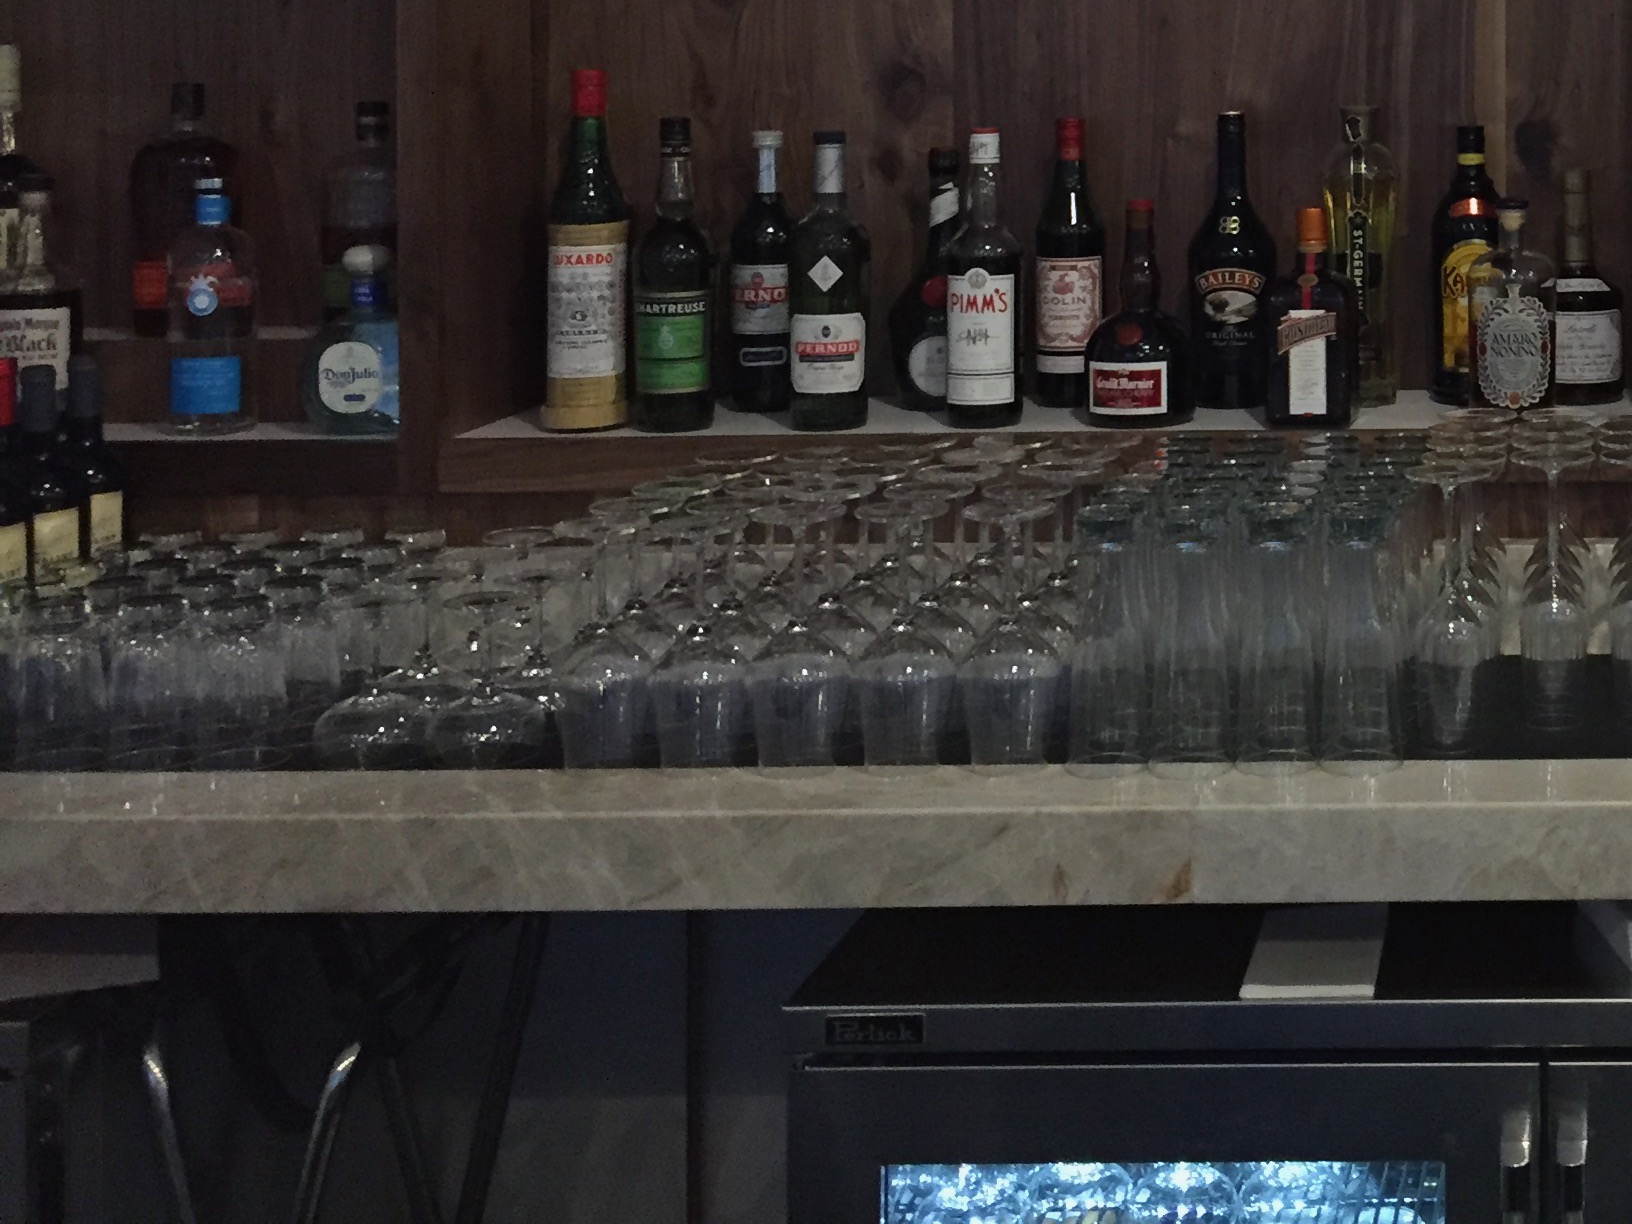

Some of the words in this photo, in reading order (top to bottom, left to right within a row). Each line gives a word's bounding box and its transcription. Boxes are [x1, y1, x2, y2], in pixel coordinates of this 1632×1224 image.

[554, 252, 614, 266] UXARDO
[1199, 271, 1262, 291] BAILEYS
[637, 301, 707, 314] HARTREUSE
[950, 288, 1009, 314] PIMM'S
[797, 341, 859, 355] PERNOD
